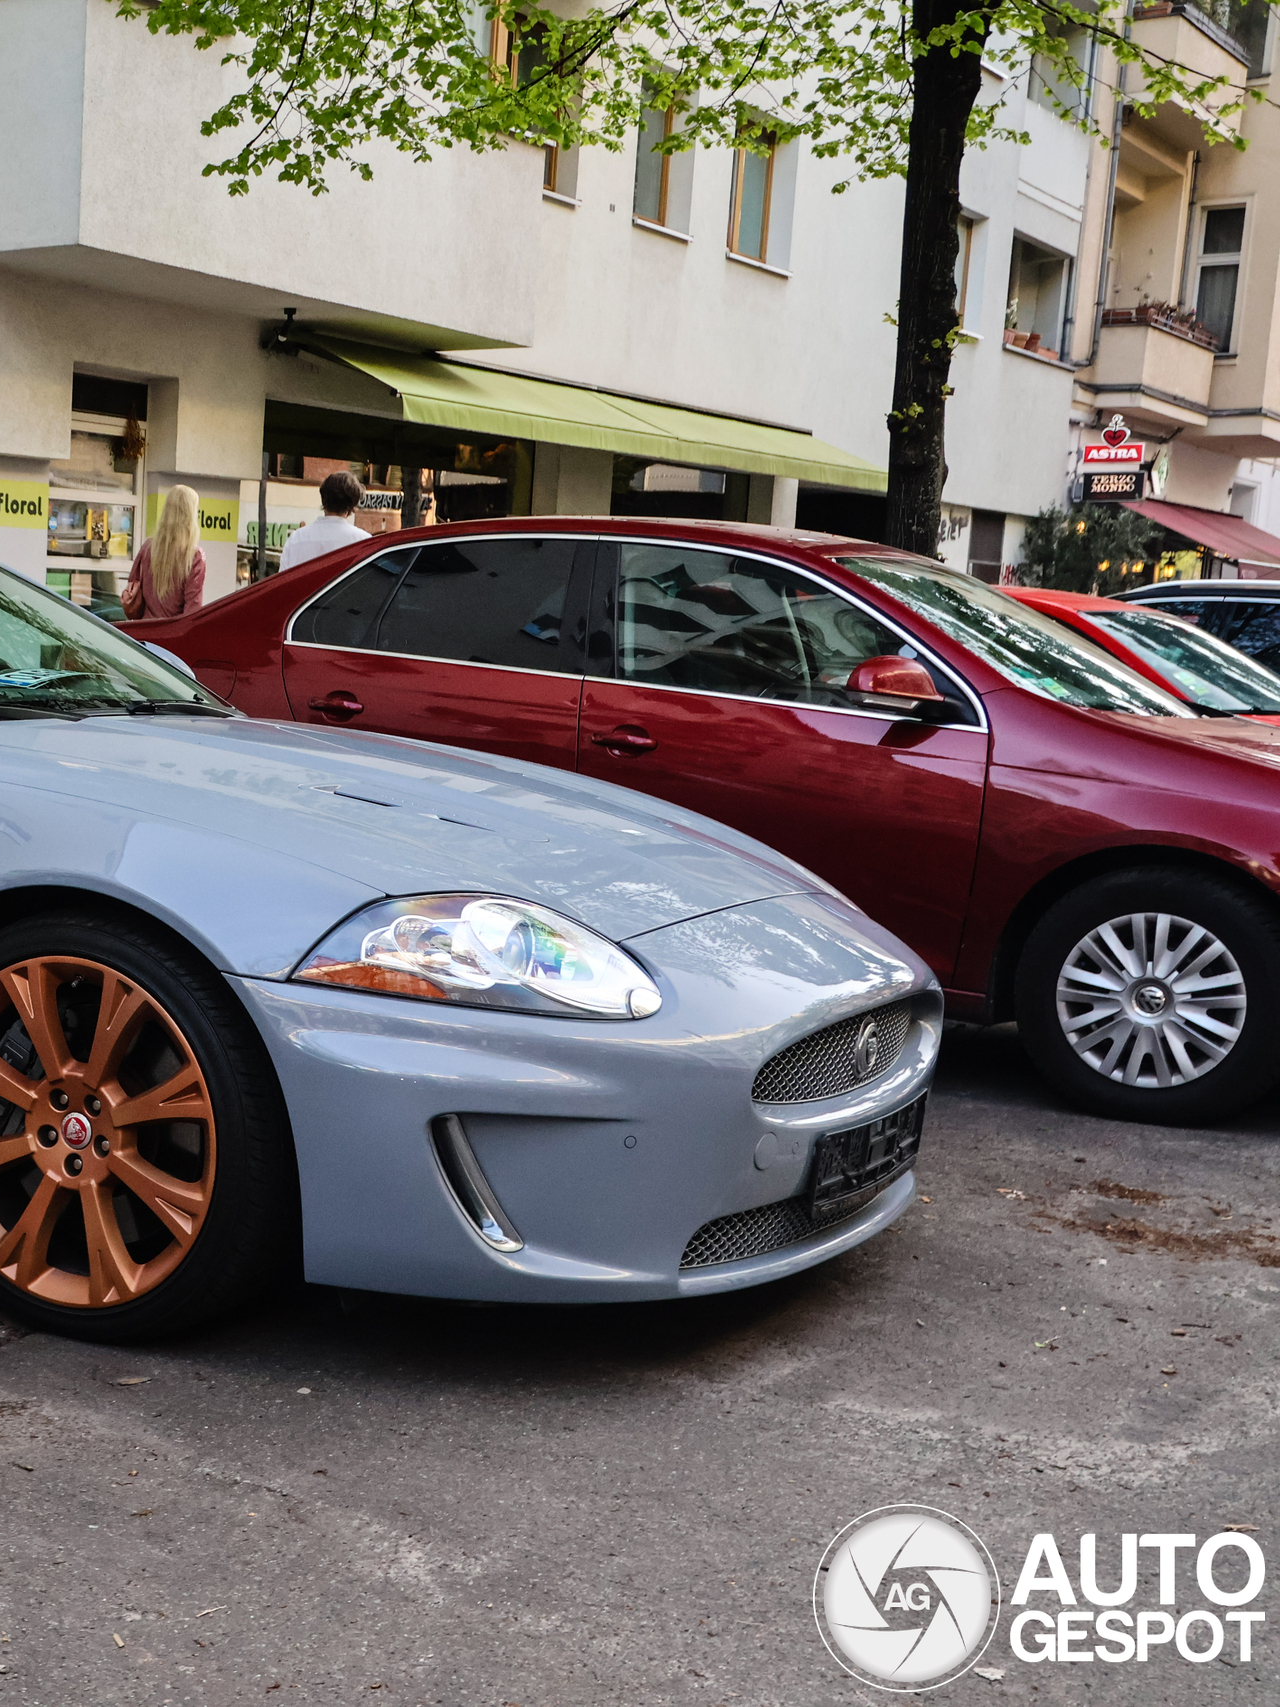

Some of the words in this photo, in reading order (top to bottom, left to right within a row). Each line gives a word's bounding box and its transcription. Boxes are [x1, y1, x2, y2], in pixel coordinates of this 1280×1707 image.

[1087, 448, 1139, 460] ASTRA
[1091, 474, 1136, 484] TERZO
[1090, 483, 1135, 493] MONDO
